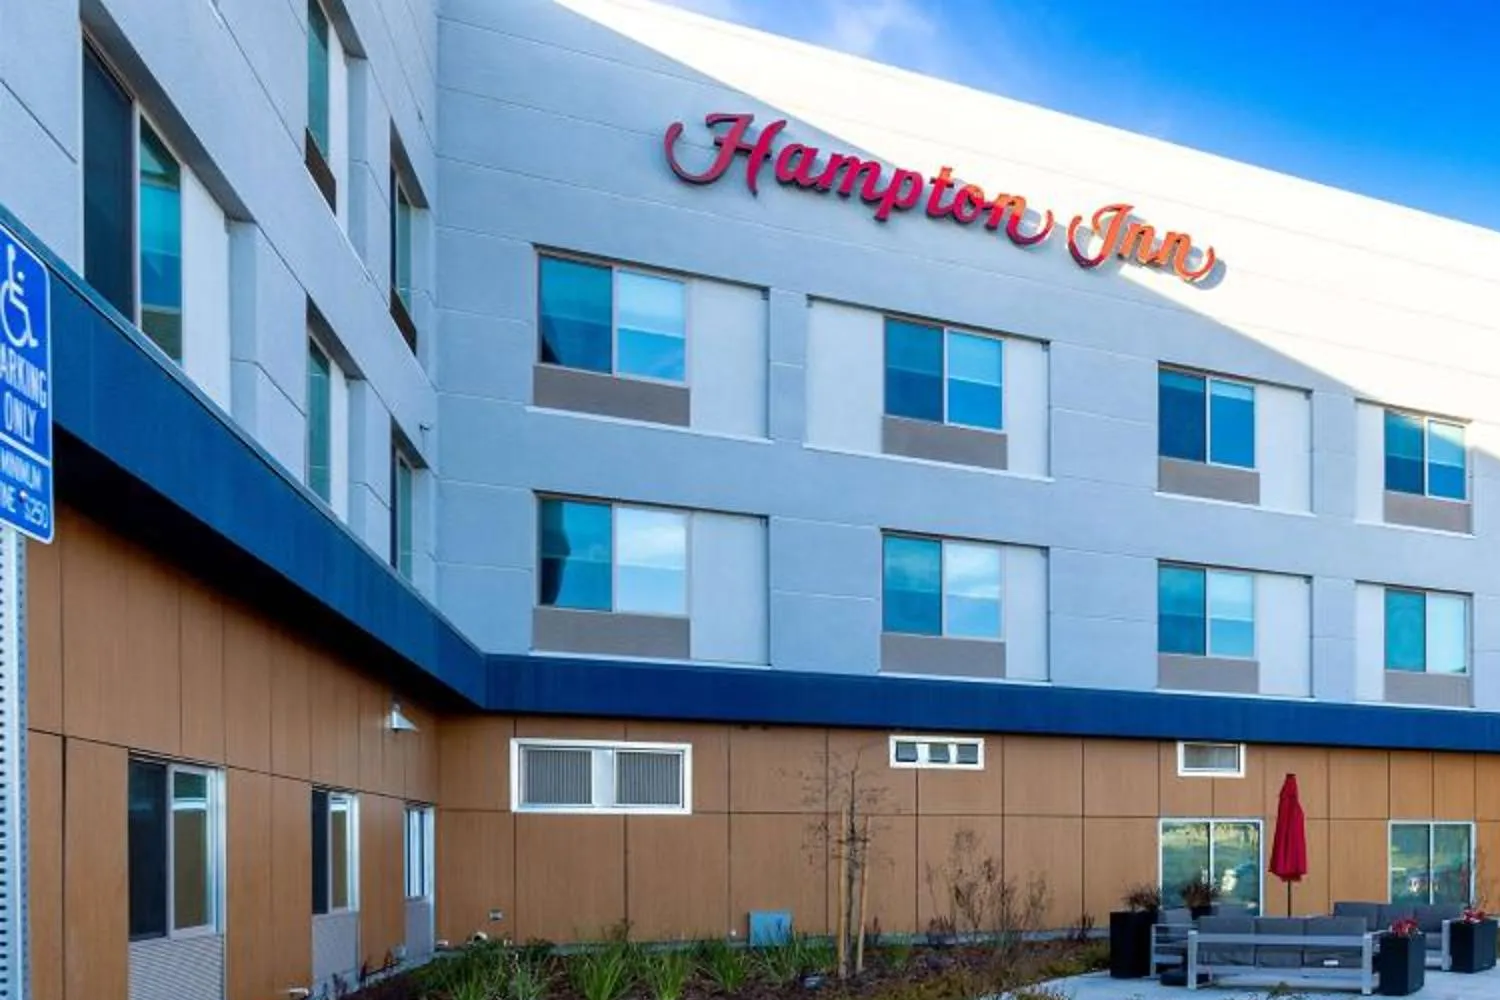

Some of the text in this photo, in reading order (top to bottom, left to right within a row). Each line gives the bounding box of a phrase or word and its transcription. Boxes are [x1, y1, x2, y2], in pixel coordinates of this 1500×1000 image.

[664, 112, 1216, 281] Hampton Inn
[4, 391, 37, 445] ONLY
